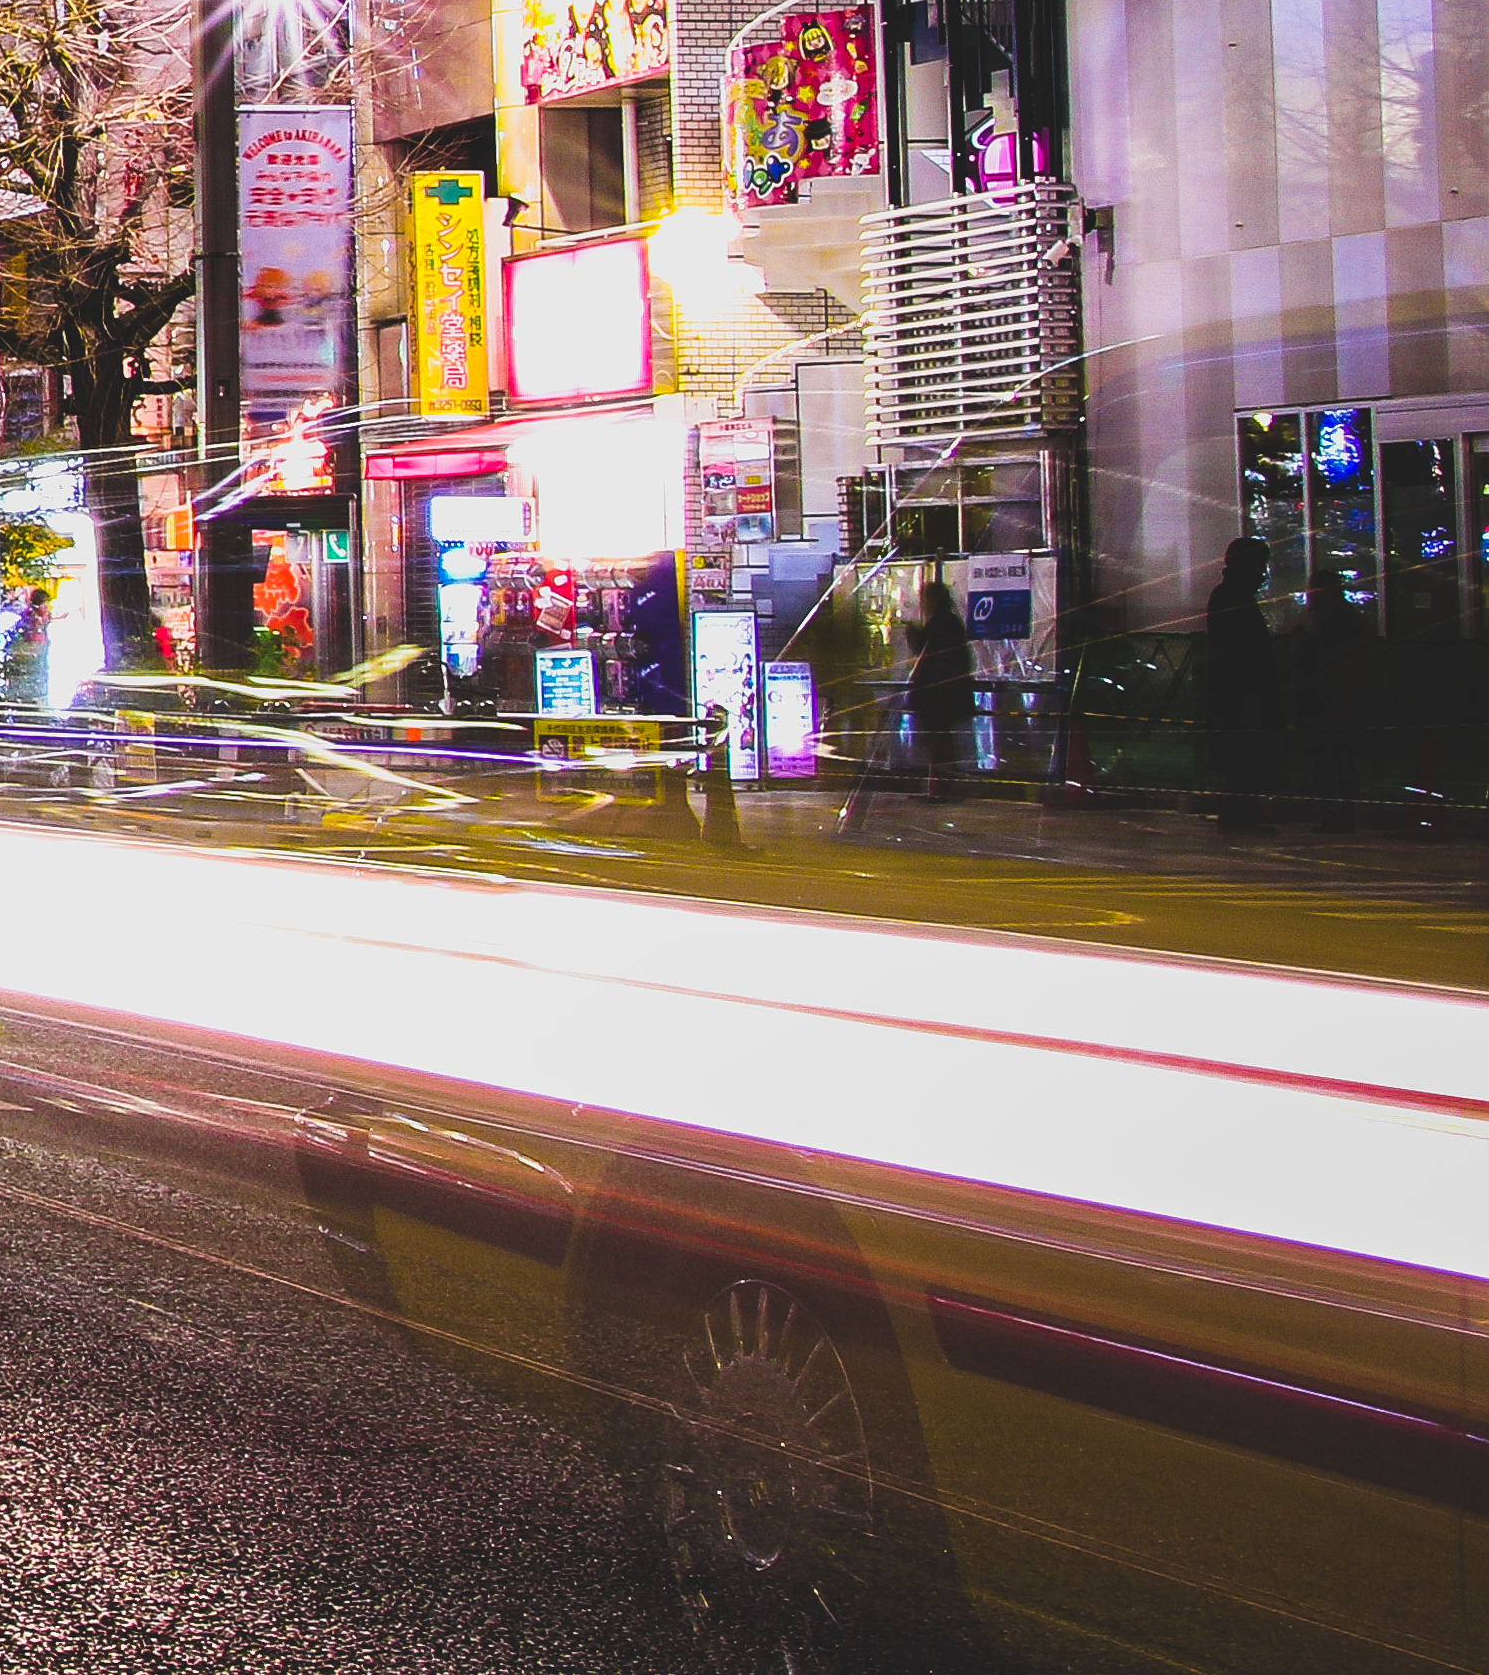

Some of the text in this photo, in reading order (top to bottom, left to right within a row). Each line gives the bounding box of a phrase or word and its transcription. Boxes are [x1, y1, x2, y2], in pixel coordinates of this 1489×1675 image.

[436, 211, 467, 390] シンセイ堂薬局
